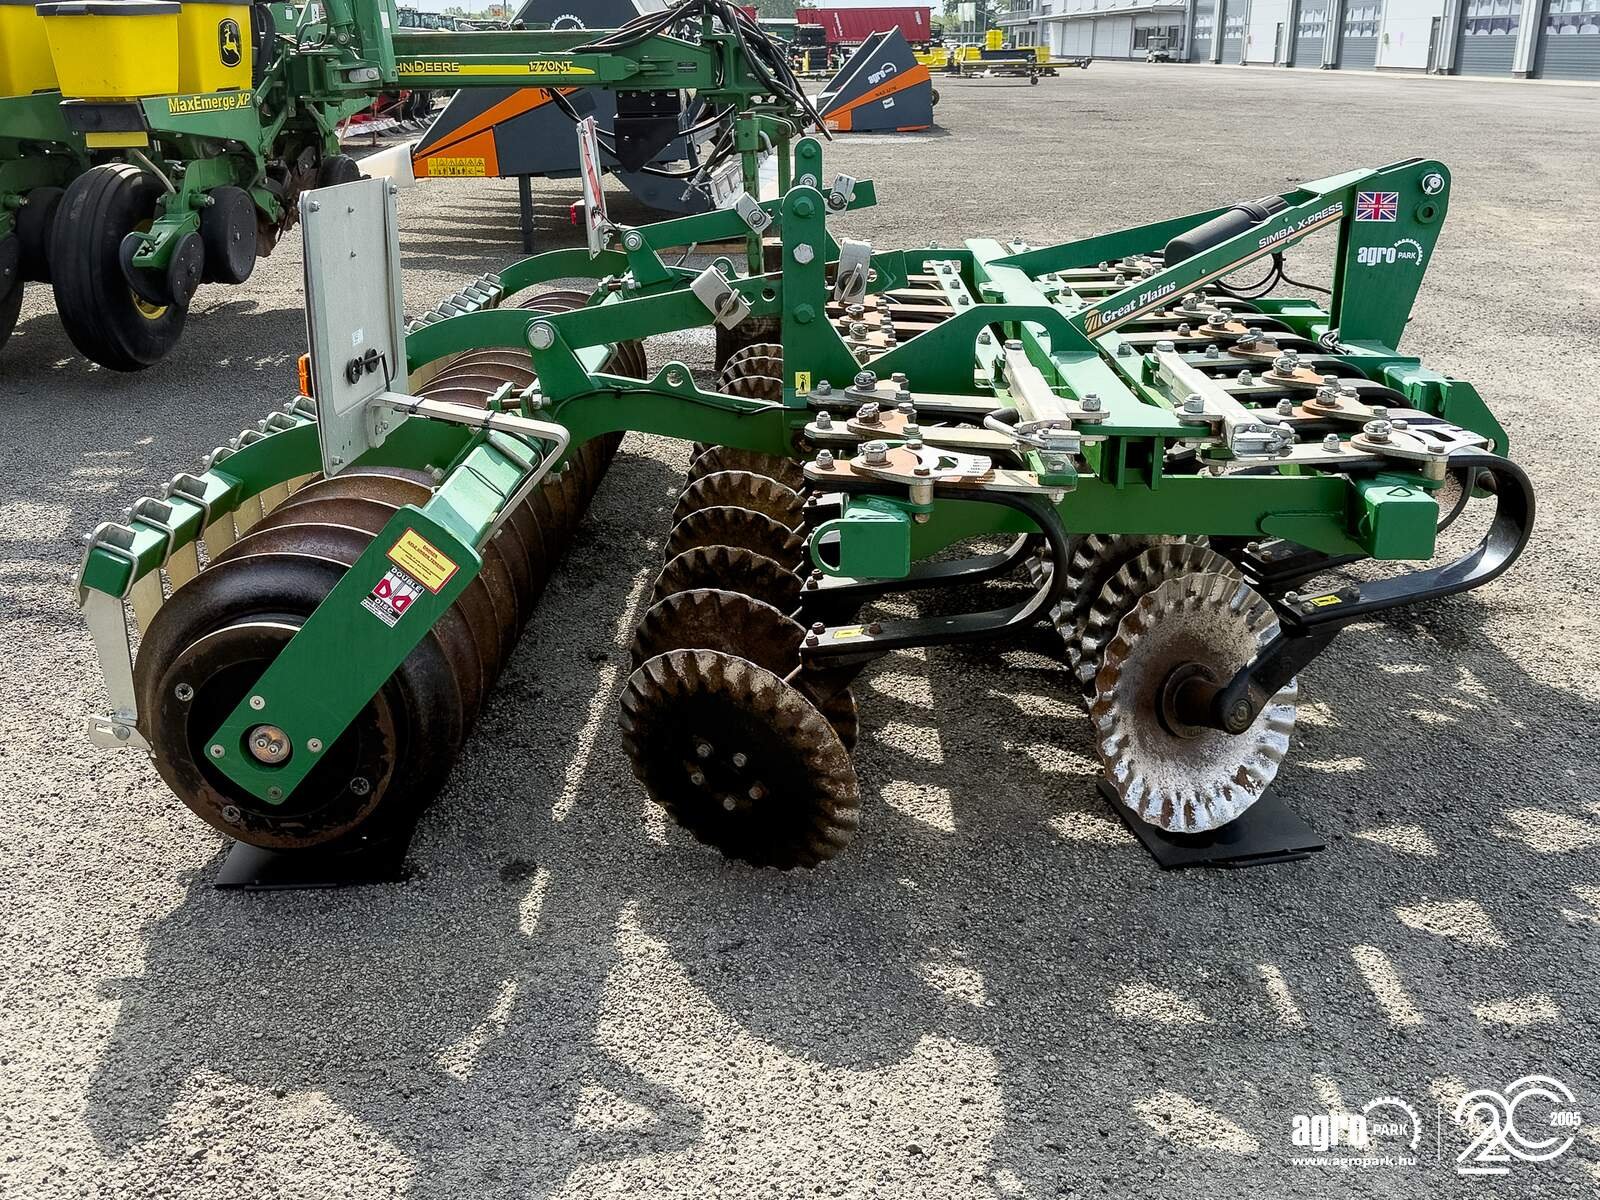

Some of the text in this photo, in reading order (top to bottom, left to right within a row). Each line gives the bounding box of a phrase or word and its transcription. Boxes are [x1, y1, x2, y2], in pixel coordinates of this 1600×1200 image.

[414, 60, 461, 73] DEERE
[528, 60, 574, 73] 1770NT
[167, 92, 251, 113] MaxEmerge XP
[1258, 201, 1344, 249] SIMBA X-PRESS
[1357, 246, 1417, 267] agro PARK
[1102, 281, 1176, 324] Great Plains
[391, 567, 423, 593] DOUBLE
[374, 598, 395, 615] DISC
